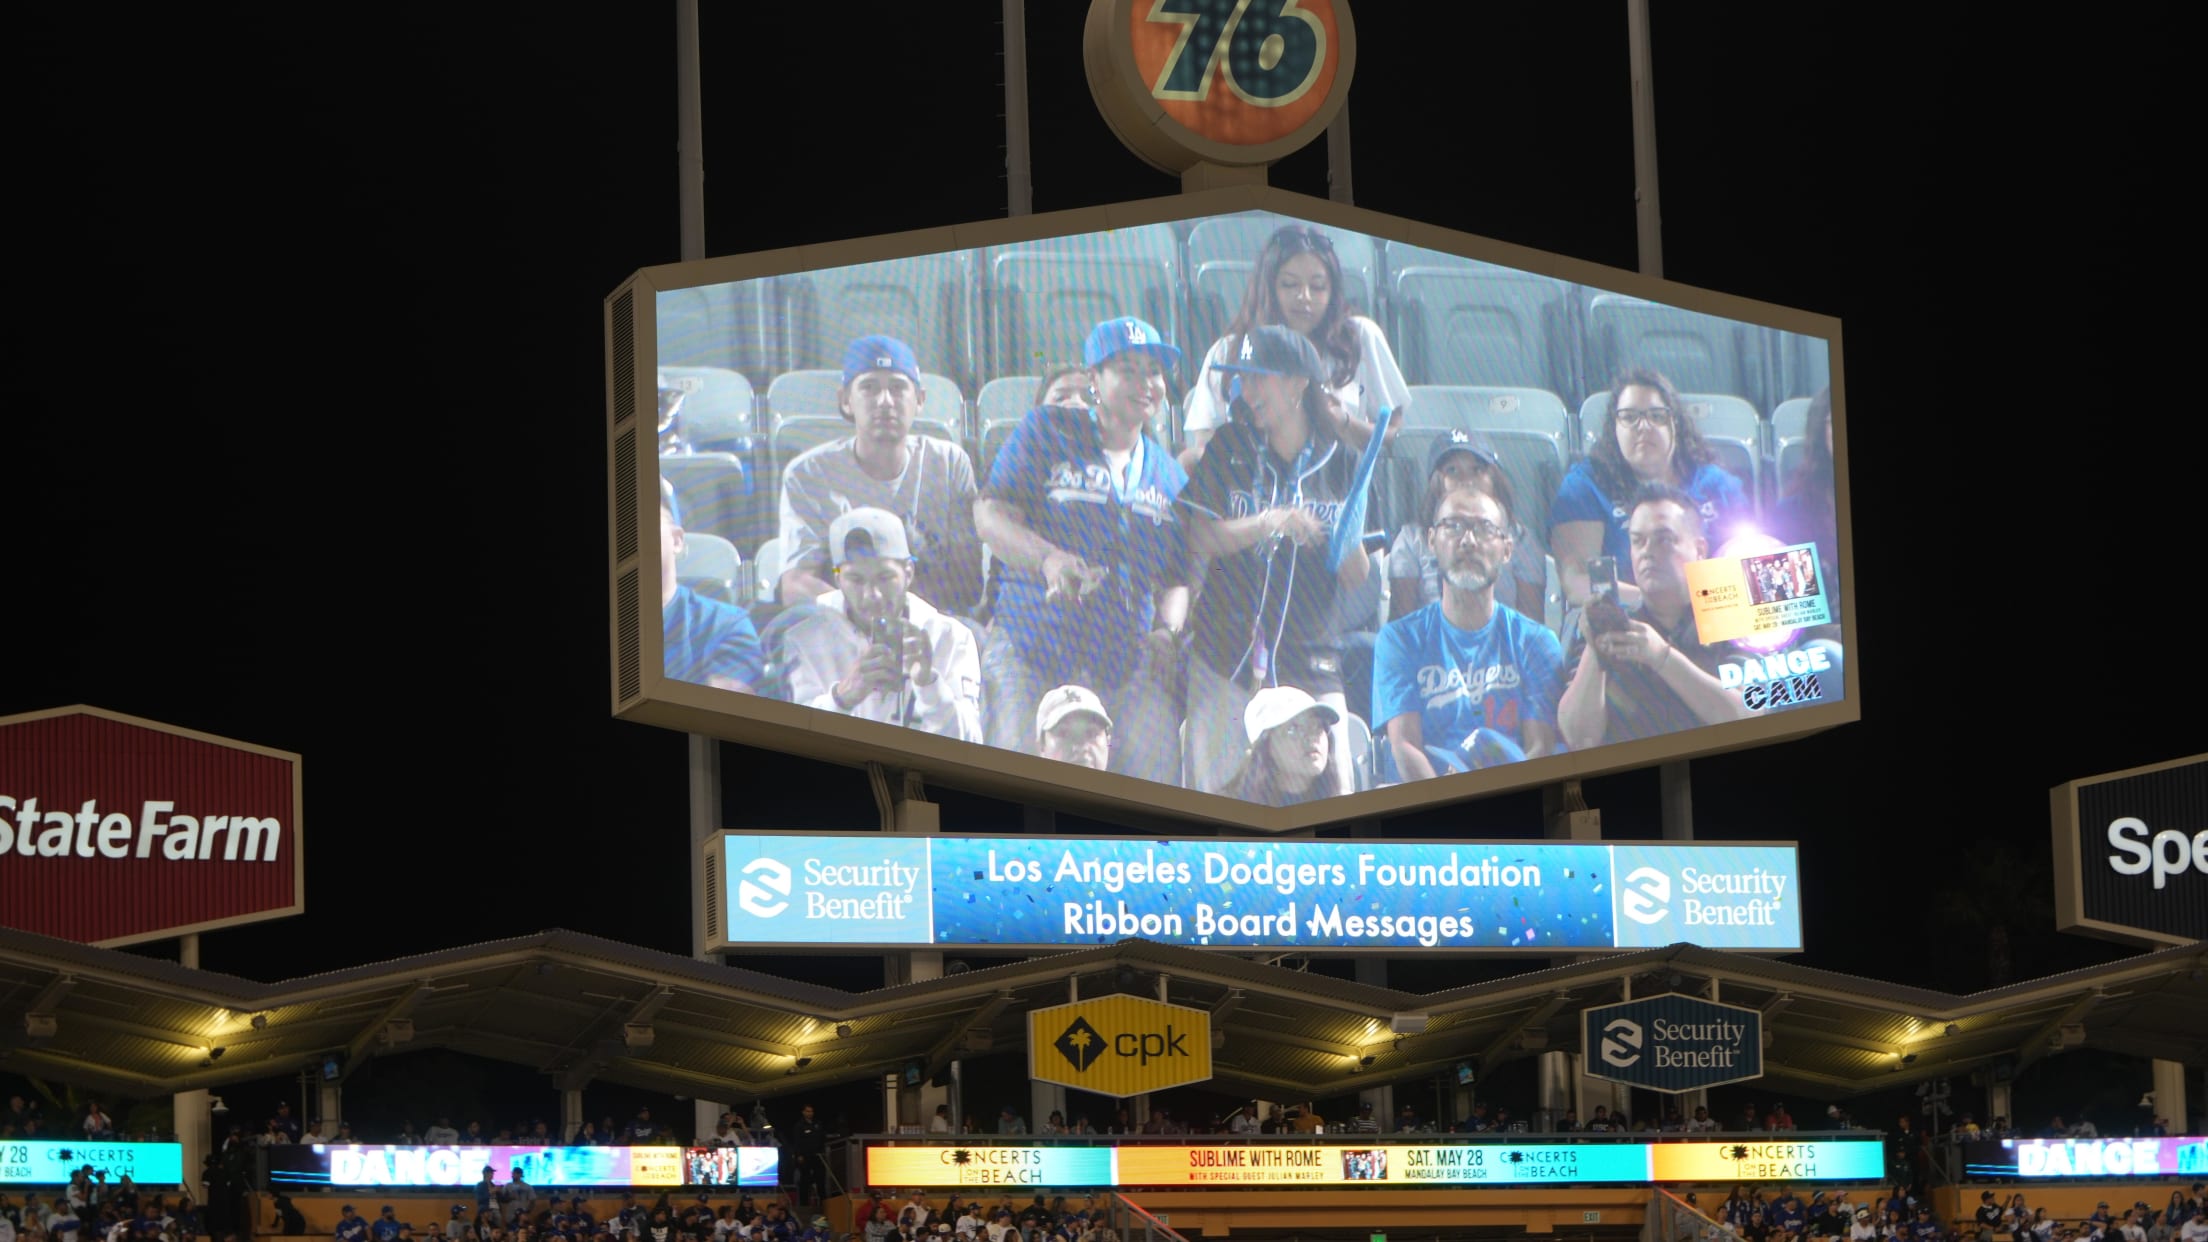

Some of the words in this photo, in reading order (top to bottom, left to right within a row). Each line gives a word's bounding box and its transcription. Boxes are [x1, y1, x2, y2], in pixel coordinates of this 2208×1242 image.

[1146, 0, 1327, 108] 76
[1718, 646, 1831, 689] DANCE
[1417, 663, 1520, 707] Dodgers
[1744, 674, 1822, 711] CAM
[0, 795, 132, 858] State
[136, 801, 280, 862] Farm
[804, 858, 920, 893] Security
[988, 850, 1042, 882] Los
[1054, 849, 1191, 892] Angeles
[1204, 850, 1345, 895] Dodgers
[1358, 852, 1541, 887] Foundation
[1682, 867, 1787, 901] Security
[1064, 900, 1182, 935] Ribbon
[1196, 902, 1296, 937] Board
[1310, 904, 1474, 947] Messages
[1115, 1025, 1189, 1066] cpk
[1653, 1018, 1745, 1046] Security
[10, 1146, 28, 1163] 28
[330, 1149, 490, 1185] DANCE
[1190, 1150, 1246, 1167] SUBLIME
[1249, 1150, 1282, 1167] WITH
[1286, 1150, 1323, 1167] ROME
[1407, 1150, 1432, 1166] SAT.
[1436, 1150, 1463, 1166] MAY
[1467, 1150, 1483, 1166] 28
[1531, 1166, 1577, 1177] BEACH
[1758, 1163, 1816, 1177] BEACH
[2018, 1141, 2160, 1175] DANCE
[5, 1167, 32, 1177] BEACH
[981, 1169, 1041, 1183] BEACH
[1210, 1171, 1239, 1180] SPECIAL
[1243, 1171, 1265, 1180] GUEST
[1405, 1169, 1445, 1179] MANDALAY
[1447, 1169, 1460, 1178] BAY
[1463, 1169, 1487, 1178] BEACH
